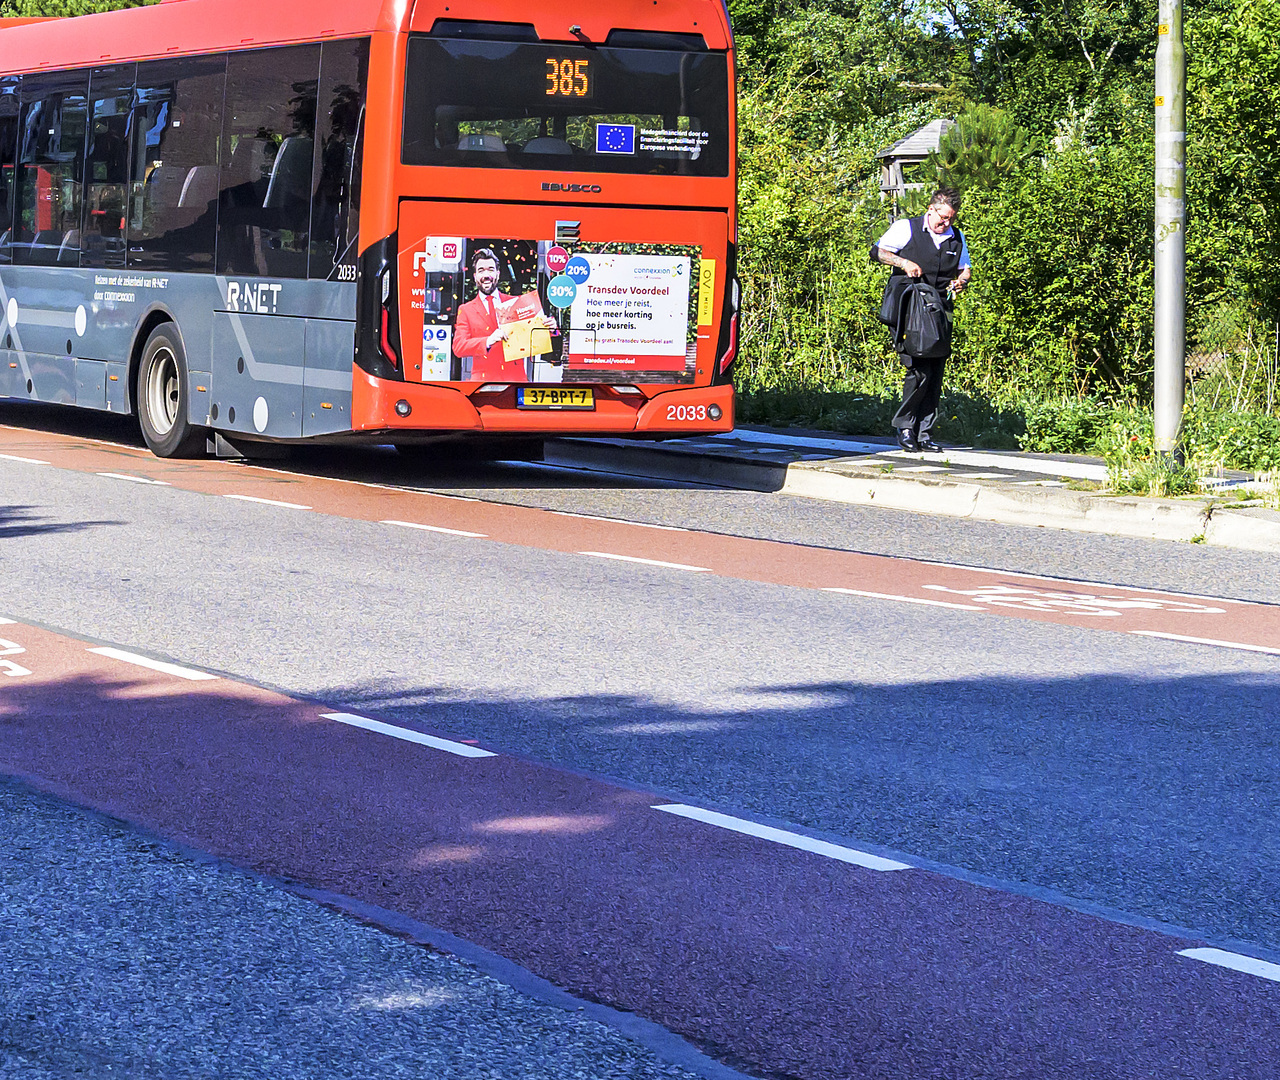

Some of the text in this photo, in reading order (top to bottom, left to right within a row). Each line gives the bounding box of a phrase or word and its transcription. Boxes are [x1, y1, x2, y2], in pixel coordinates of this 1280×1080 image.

[546, 59, 589, 96] 385
[540, 182, 602, 193] EBUSCO
[548, 254, 567, 264] 10%
[337, 264, 357, 280] 2033
[567, 265, 588, 276] 20%
[703, 269, 711, 289] OV
[550, 285, 574, 297] 30%
[587, 285, 670, 295] Transdev Voordeel
[624, 299, 632, 308] je
[634, 299, 652, 308] reist,
[586, 309, 601, 317] hoe
[624, 310, 653, 320] korting
[586, 321, 637, 330] op je busreis.
[530, 390, 587, 404] 37-BPT-7
[666, 405, 707, 421] 2033
